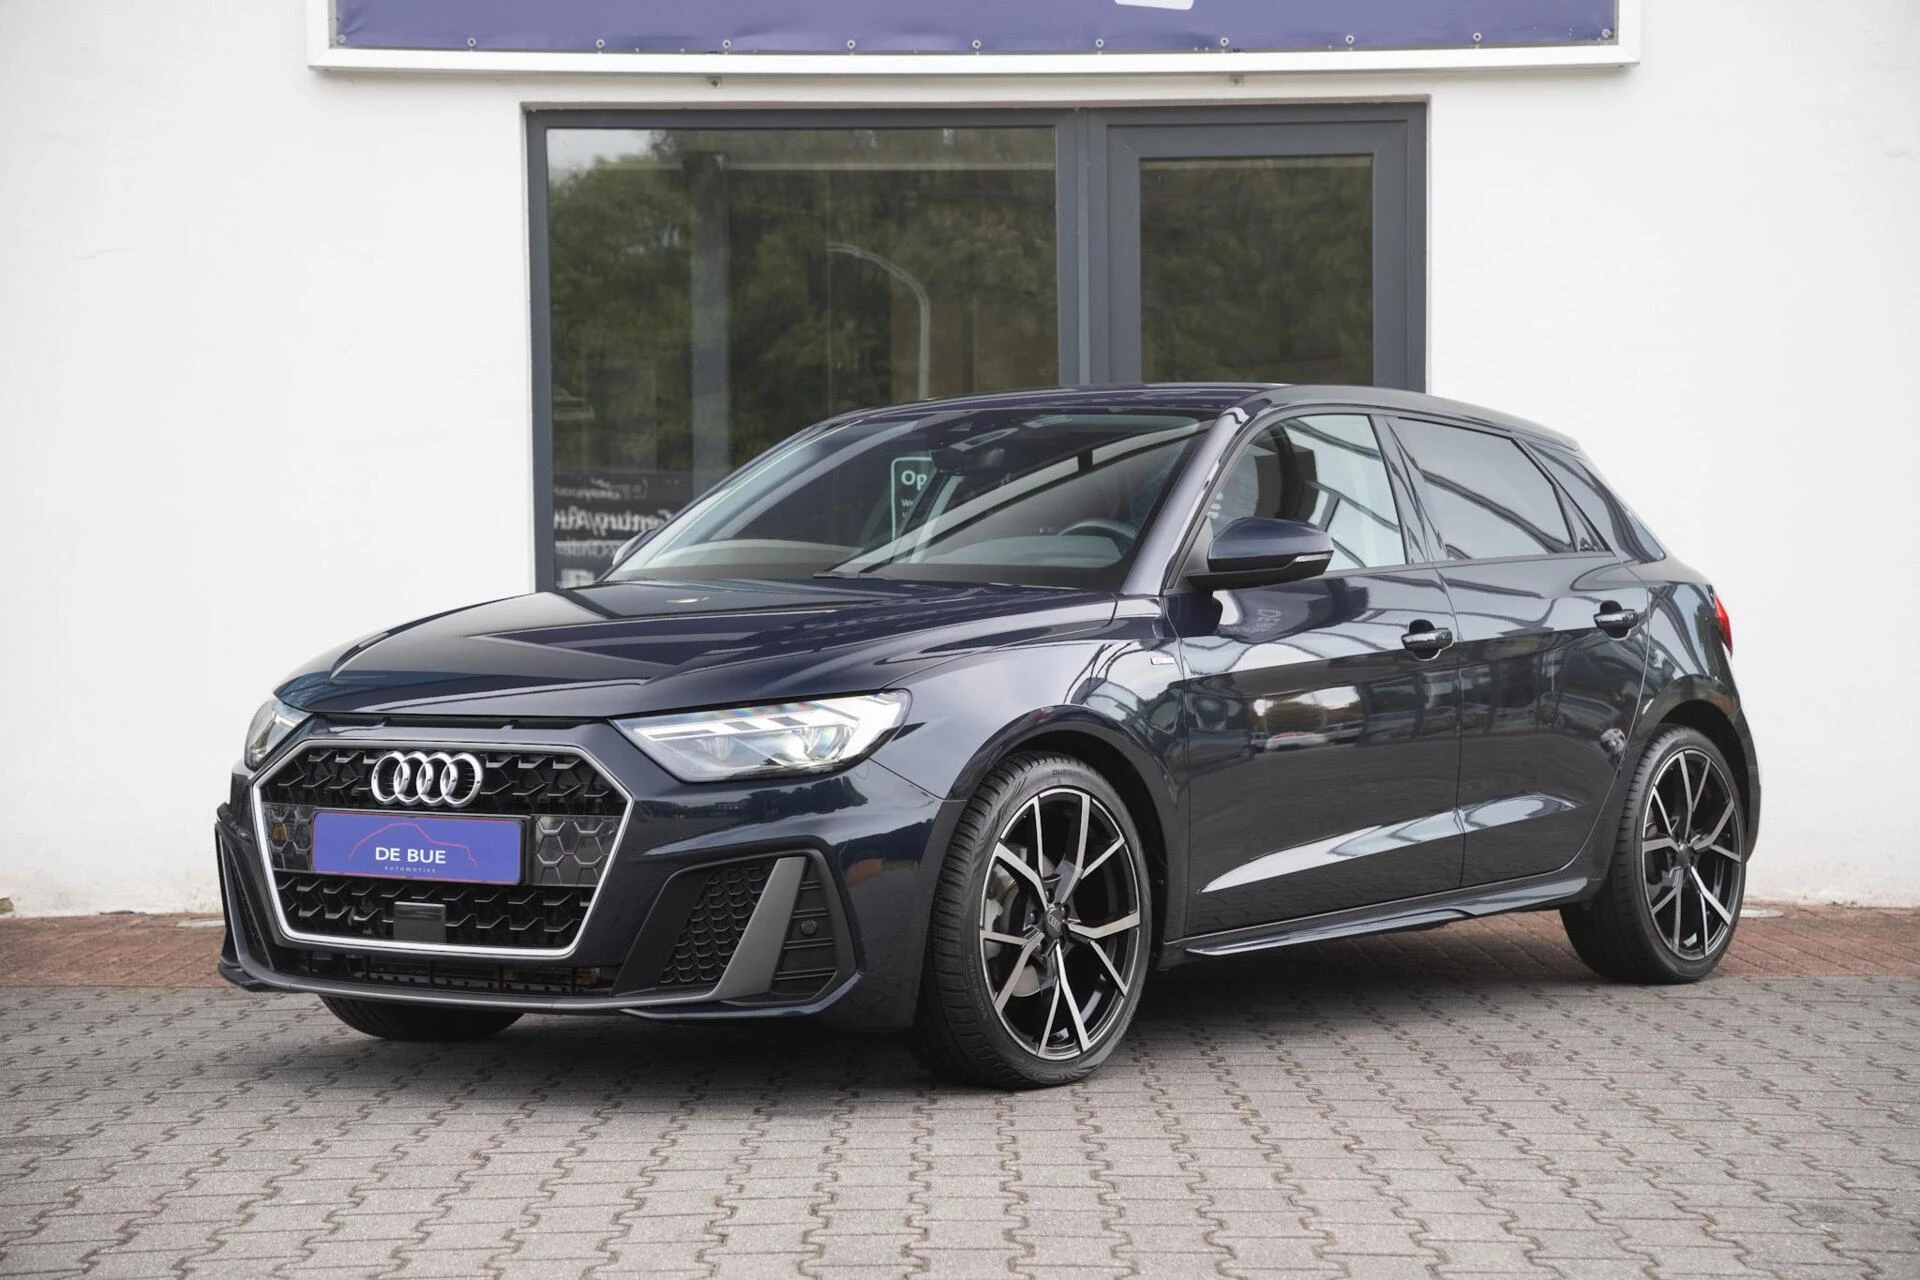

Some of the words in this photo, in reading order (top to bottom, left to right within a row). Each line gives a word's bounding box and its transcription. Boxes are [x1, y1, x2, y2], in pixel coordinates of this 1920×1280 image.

[375, 846, 401, 862] DE
[407, 848, 447, 864] BUE
[384, 865, 437, 874] AUTOMOTIVE
